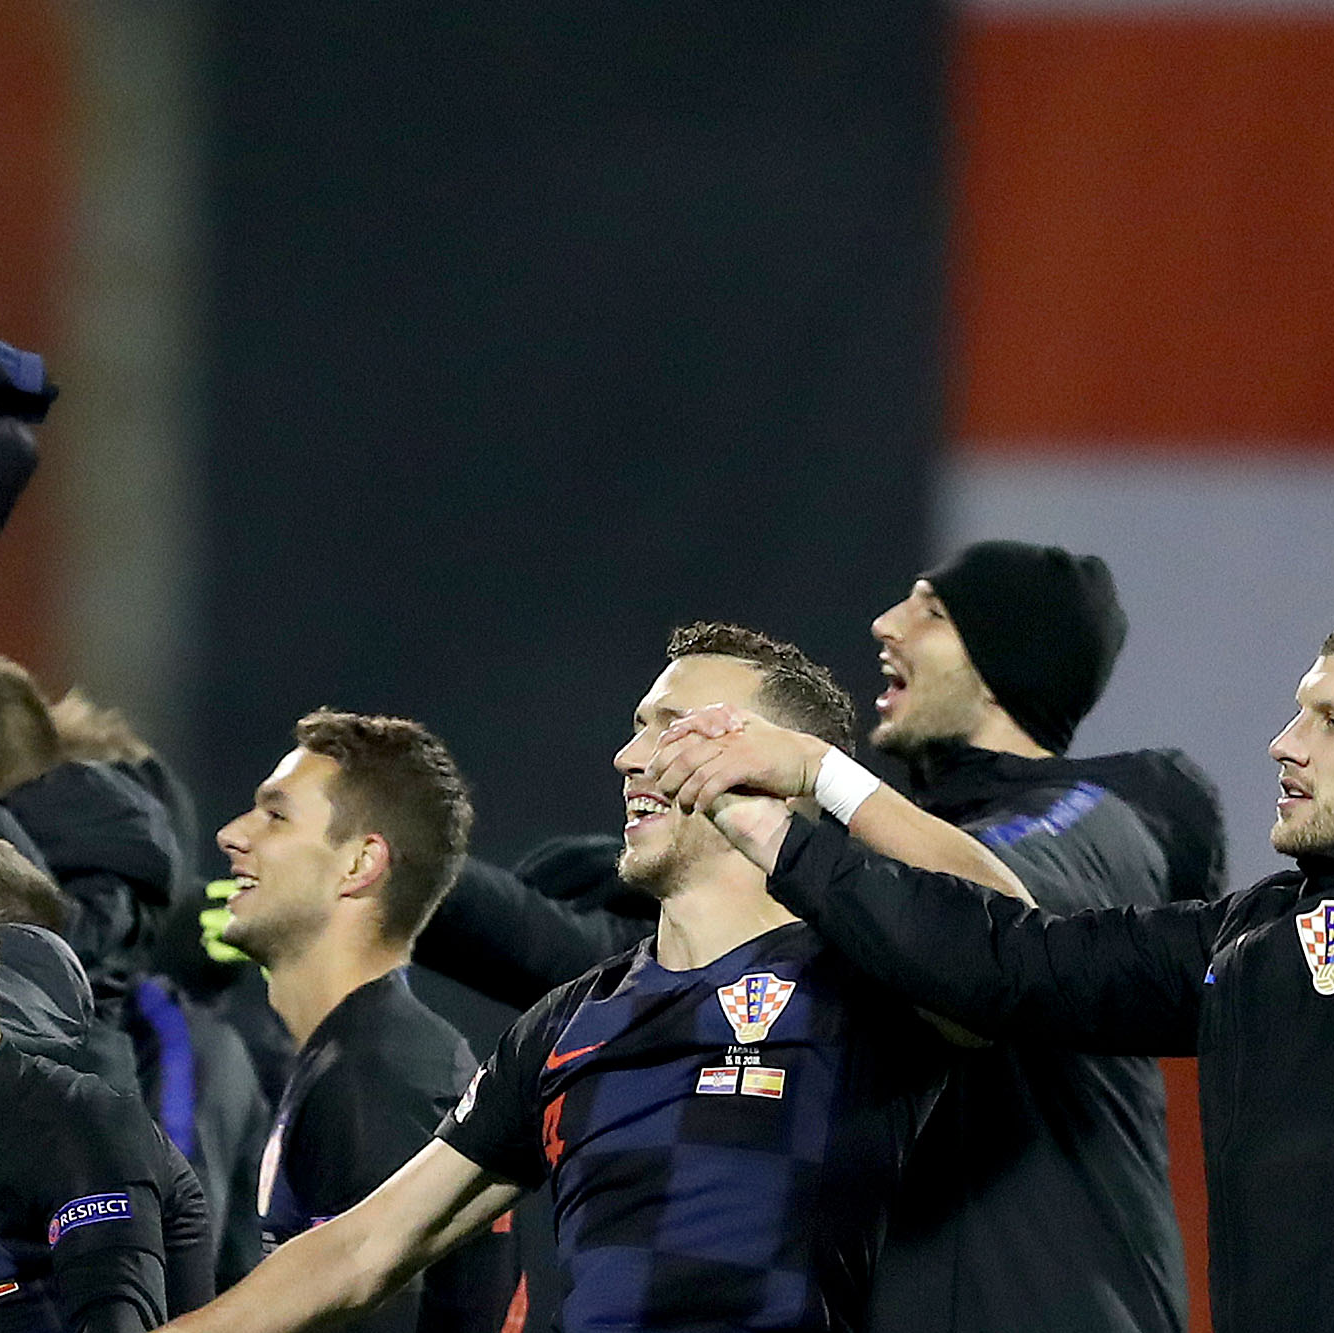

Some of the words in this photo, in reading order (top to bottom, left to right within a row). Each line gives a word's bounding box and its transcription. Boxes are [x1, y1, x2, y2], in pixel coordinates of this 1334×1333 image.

[748, 980, 763, 1017] HNS
[541, 1092, 566, 1166] 4
[59, 1199, 129, 1227] RESPECT
